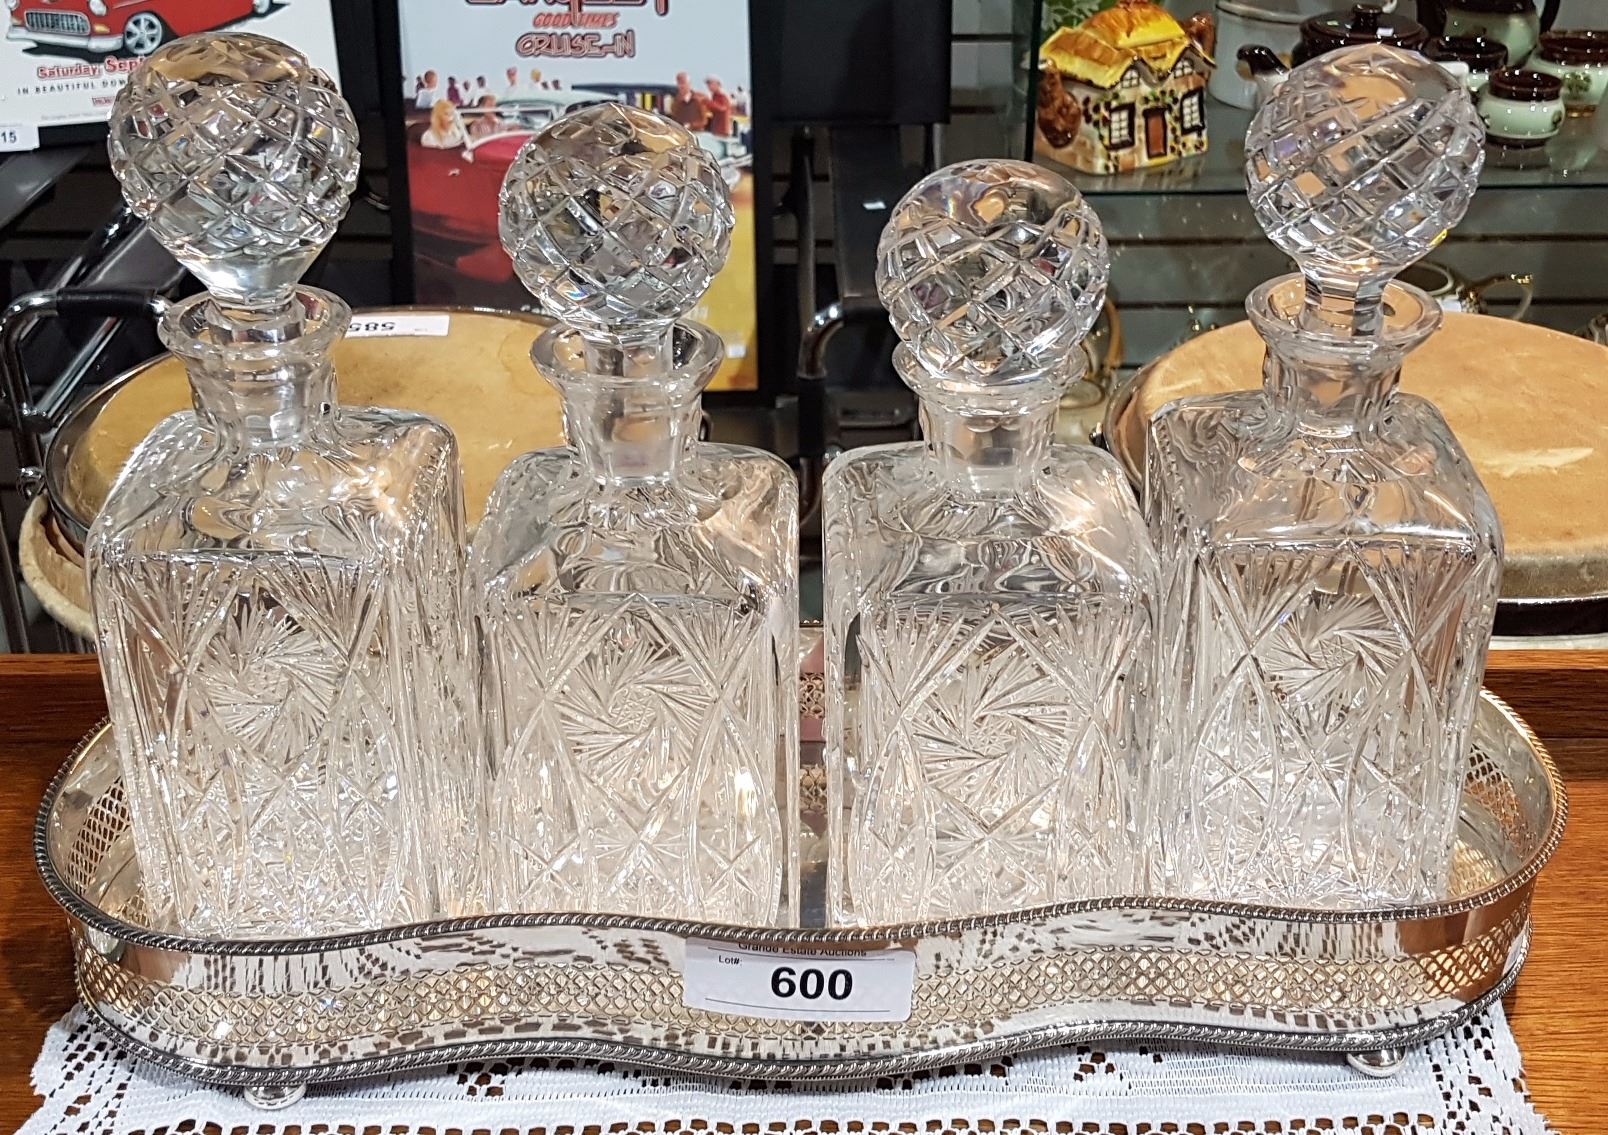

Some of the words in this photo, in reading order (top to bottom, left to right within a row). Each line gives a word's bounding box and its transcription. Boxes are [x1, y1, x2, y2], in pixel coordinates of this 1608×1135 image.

[515, 29, 635, 58] CRUISE-IN
[18, 86, 29, 95] IN
[35, 80, 95, 94] BEAUTIFUL
[718, 954, 743, 967] Lot#:
[770, 966, 853, 1001] 600
